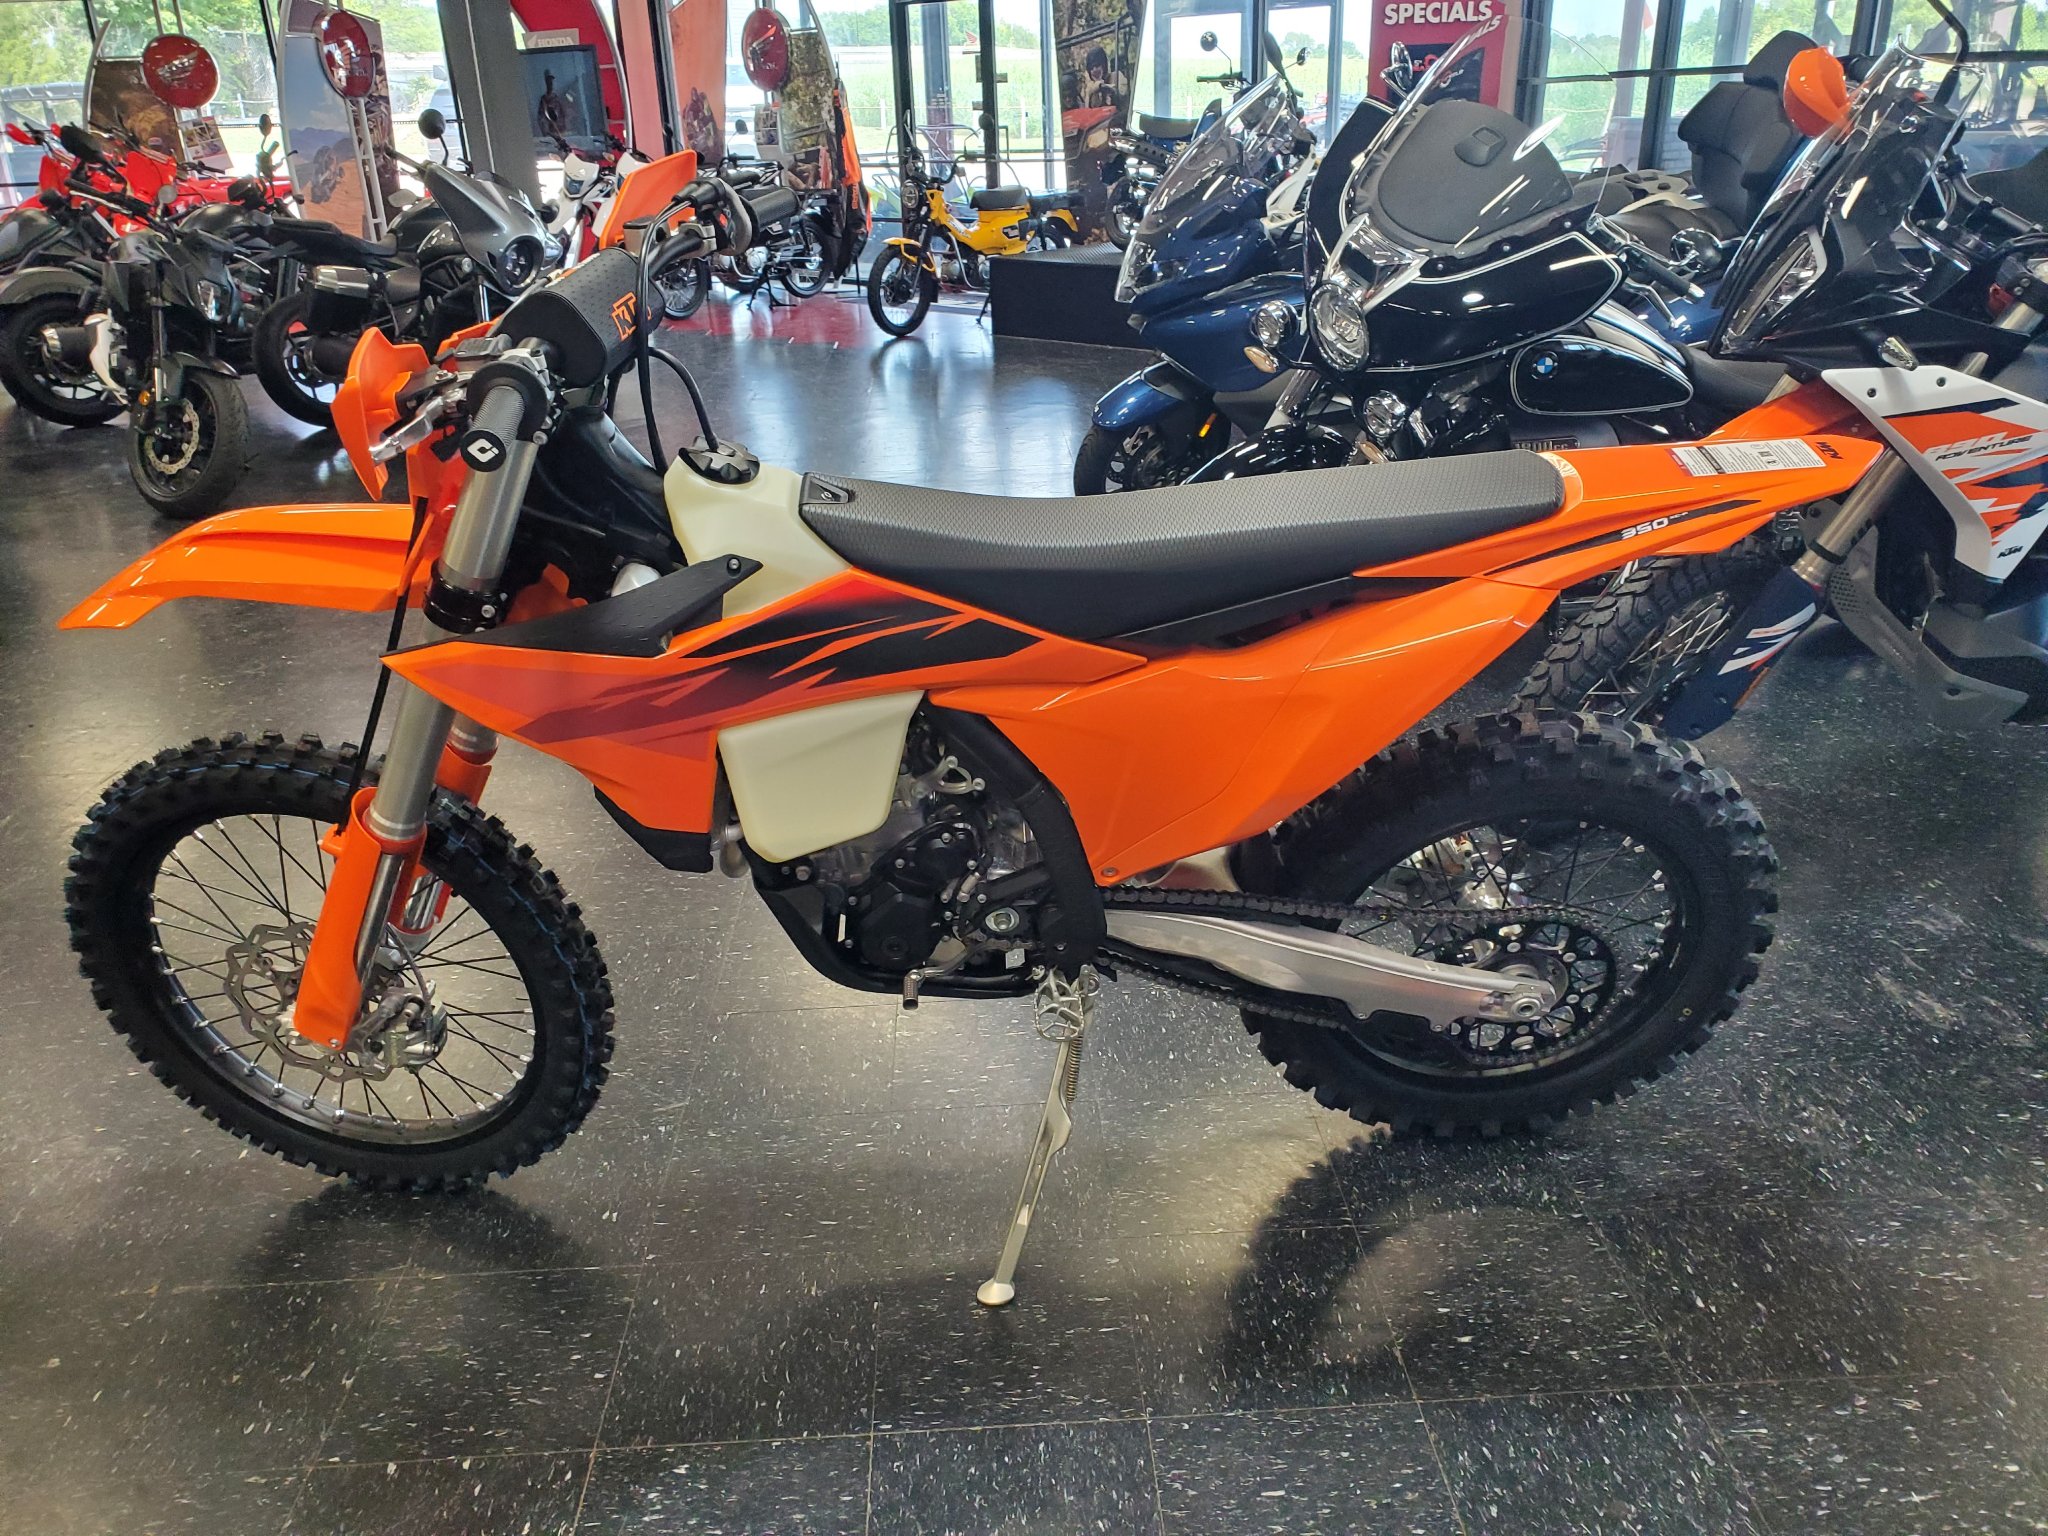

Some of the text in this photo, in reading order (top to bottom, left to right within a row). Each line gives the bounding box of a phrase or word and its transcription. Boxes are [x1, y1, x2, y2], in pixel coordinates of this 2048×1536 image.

[1384, 0, 1493, 25] SPECIALS
[537, 36, 574, 47] HONDA
[1935, 435, 2033, 461] ADVENTURE
[1621, 517, 1669, 540] 350
